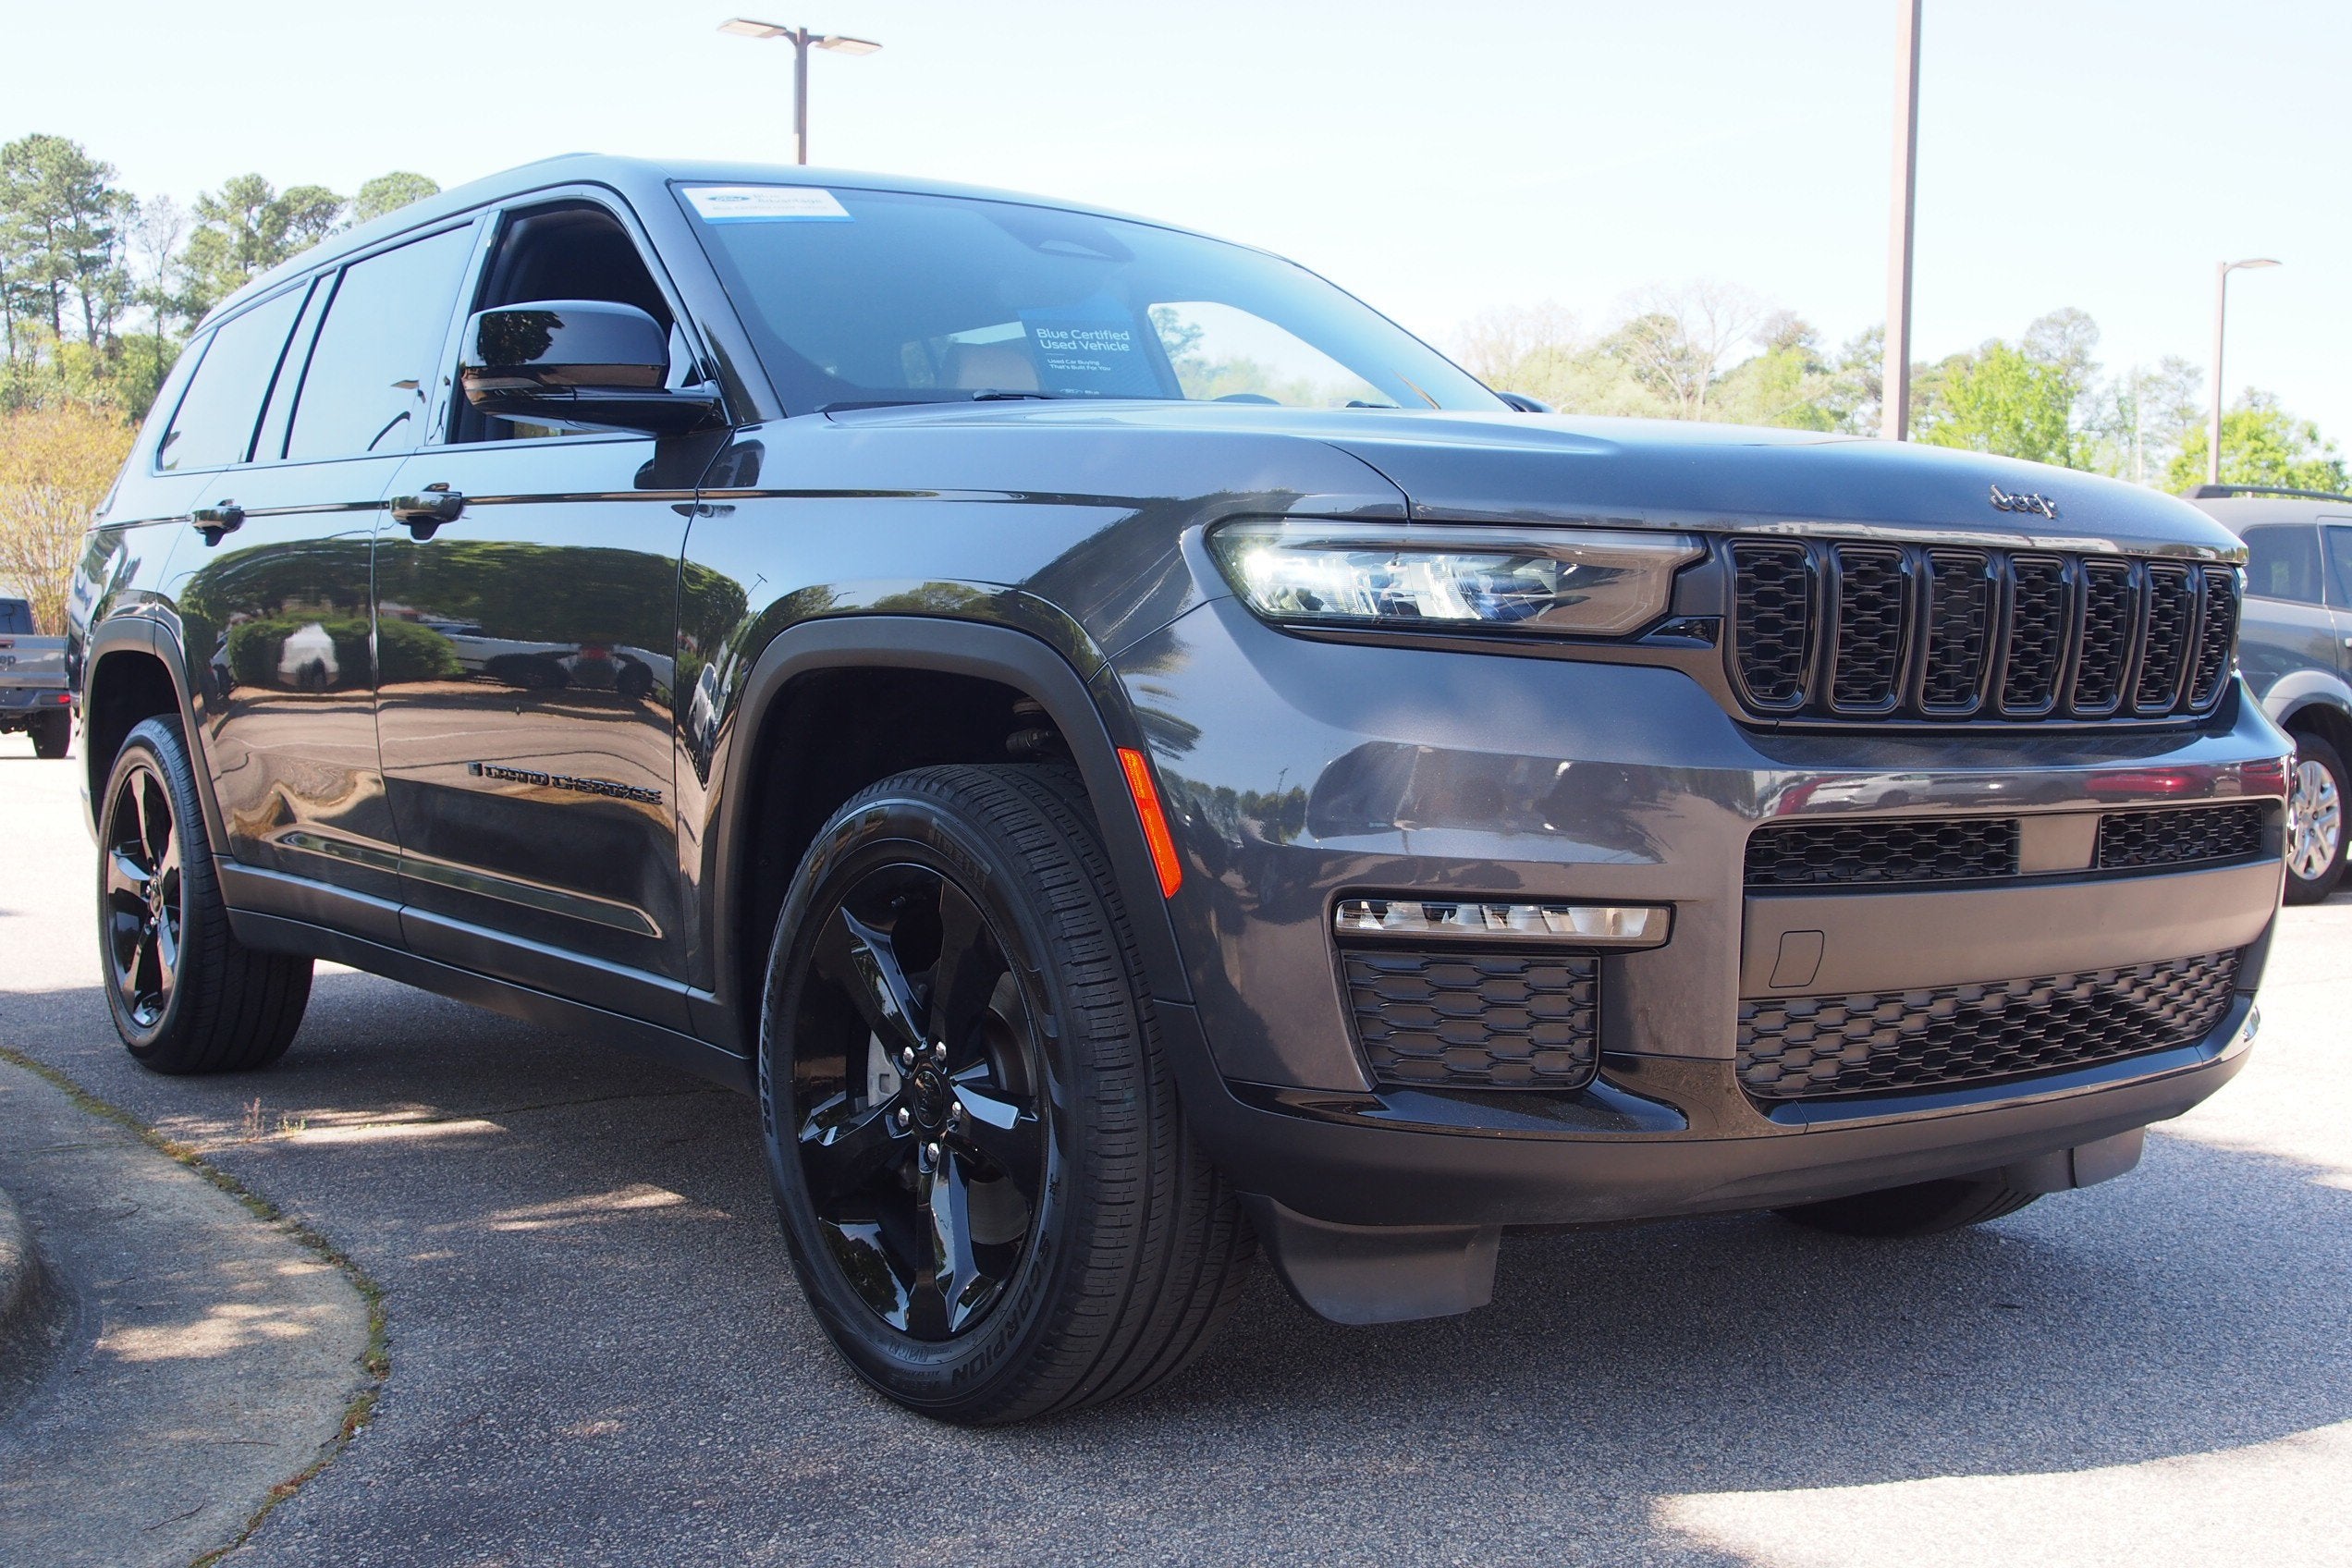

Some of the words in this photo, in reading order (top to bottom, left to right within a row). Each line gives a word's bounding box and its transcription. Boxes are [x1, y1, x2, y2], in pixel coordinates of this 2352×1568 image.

[1036, 328, 1069, 338] Blue
[1072, 329, 1130, 340] Certified
[1040, 339, 1077, 349] Used
[1079, 340, 1130, 351] Vehicle
[1990, 484, 2059, 520] Jeep
[0, 655, 17, 668] ep
[484, 764, 550, 786] GRAND
[551, 773, 663, 805] CHEROKEE
[950, 1230, 1052, 1390] SCORPION
